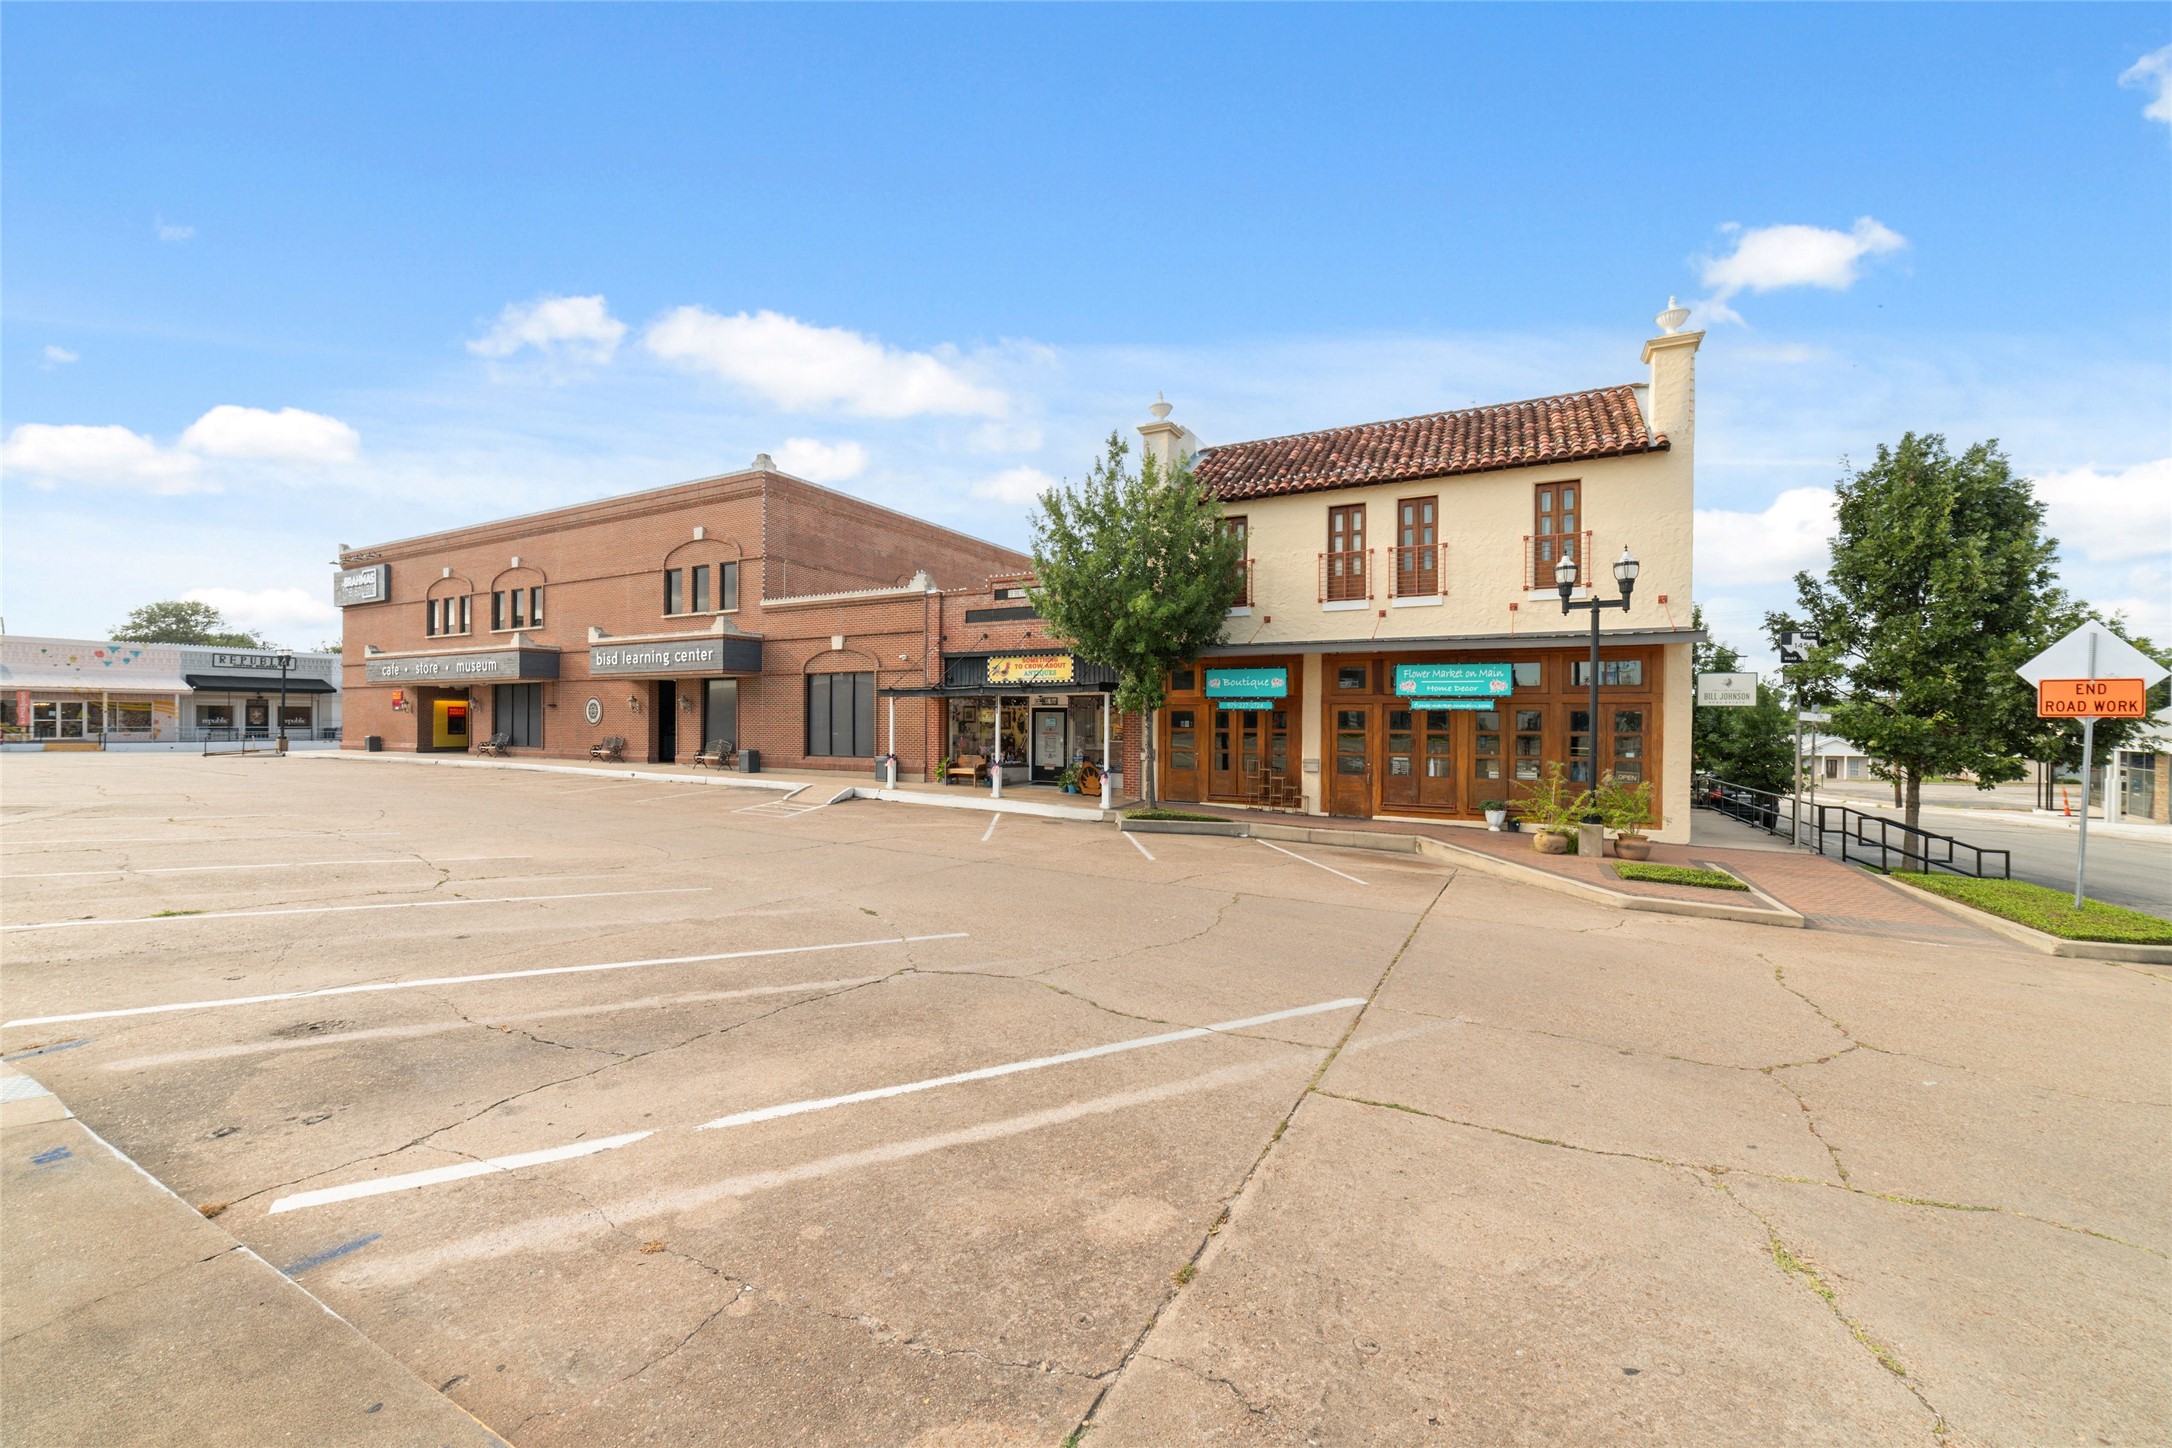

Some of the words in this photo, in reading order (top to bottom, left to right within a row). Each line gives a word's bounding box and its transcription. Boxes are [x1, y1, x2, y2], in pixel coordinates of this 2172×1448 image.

[343, 573, 376, 588] BRAHMAS
[219, 655, 289, 667] REPUBL
[596, 651, 618, 666] bisd
[622, 650, 670, 666] learning
[674, 648, 714, 662] center
[381, 662, 400, 676] cafe
[415, 663, 439, 675] store
[456, 660, 497, 673] museum
[1023, 669, 1057, 677] ANTIQUES
[1403, 669, 1431, 679] Flower
[1432, 668, 1463, 679] Market
[1465, 670, 1477, 678] on
[1479, 666, 1504, 678] Main
[1222, 676, 1269, 689] Boutique
[2075, 683, 2107, 695] END
[1703, 692, 1718, 701] BILL
[1719, 692, 1750, 701] JOHNSON
[2045, 700, 2087, 712] ROAD
[2094, 700, 2138, 712] WORK
[201, 716, 229, 725] republic
[284, 717, 307, 725] epublic
